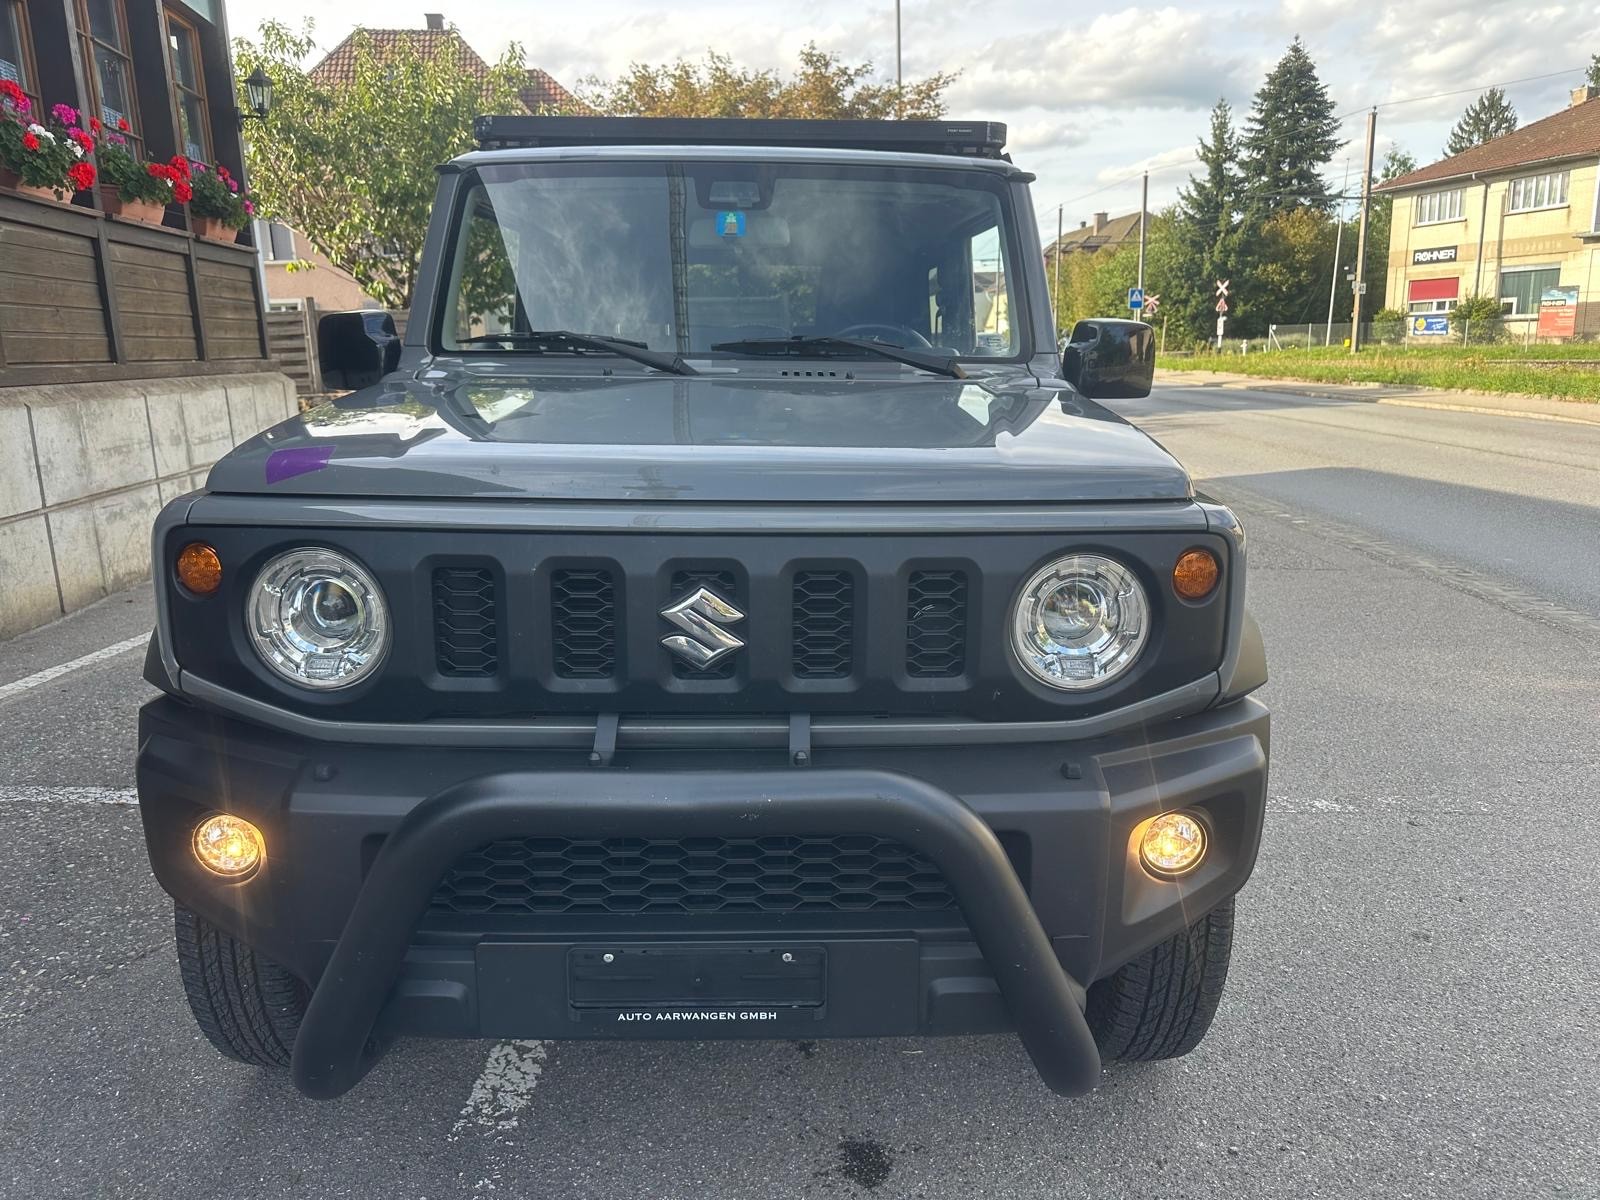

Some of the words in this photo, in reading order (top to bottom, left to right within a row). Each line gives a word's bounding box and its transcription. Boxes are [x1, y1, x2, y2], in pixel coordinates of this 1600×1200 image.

[1414, 249, 1455, 262] ROHNER
[617, 1013, 652, 1021] AUTO
[655, 1012, 736, 1020] AARWANGEN
[739, 1012, 777, 1020] GMBH
